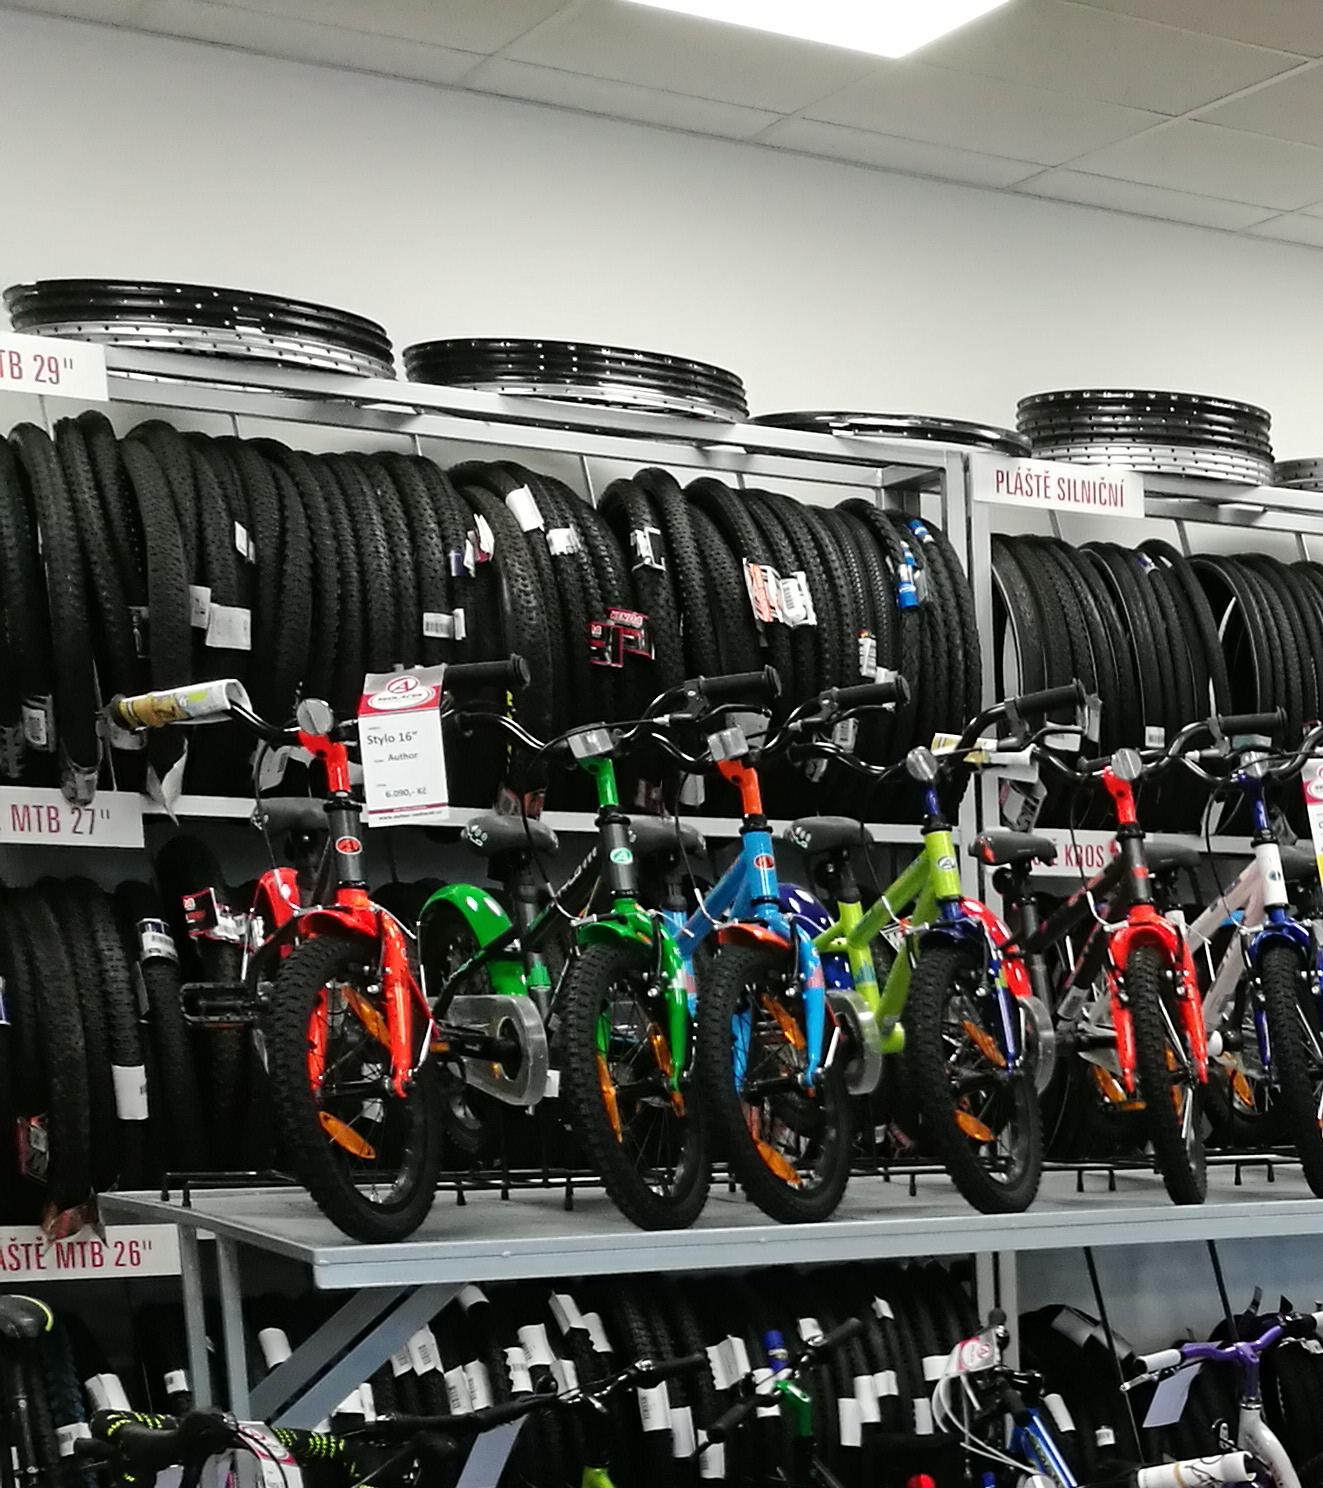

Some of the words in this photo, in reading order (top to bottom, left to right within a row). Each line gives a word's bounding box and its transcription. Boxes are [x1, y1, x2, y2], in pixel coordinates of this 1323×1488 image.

[33, 354, 73, 385] 29"
[996, 466, 1051, 499] PLÁŠTĚ
[1057, 476, 1125, 508] SILNIČNÍ
[367, 732, 395, 747] Stylo
[388, 752, 418, 761] Author
[11, 804, 60, 833] MTB
[71, 806, 110, 835] 27"
[1065, 844, 1105, 867] KROS
[55, 1240, 104, 1269] MTB
[113, 1239, 153, 1268] 26"
